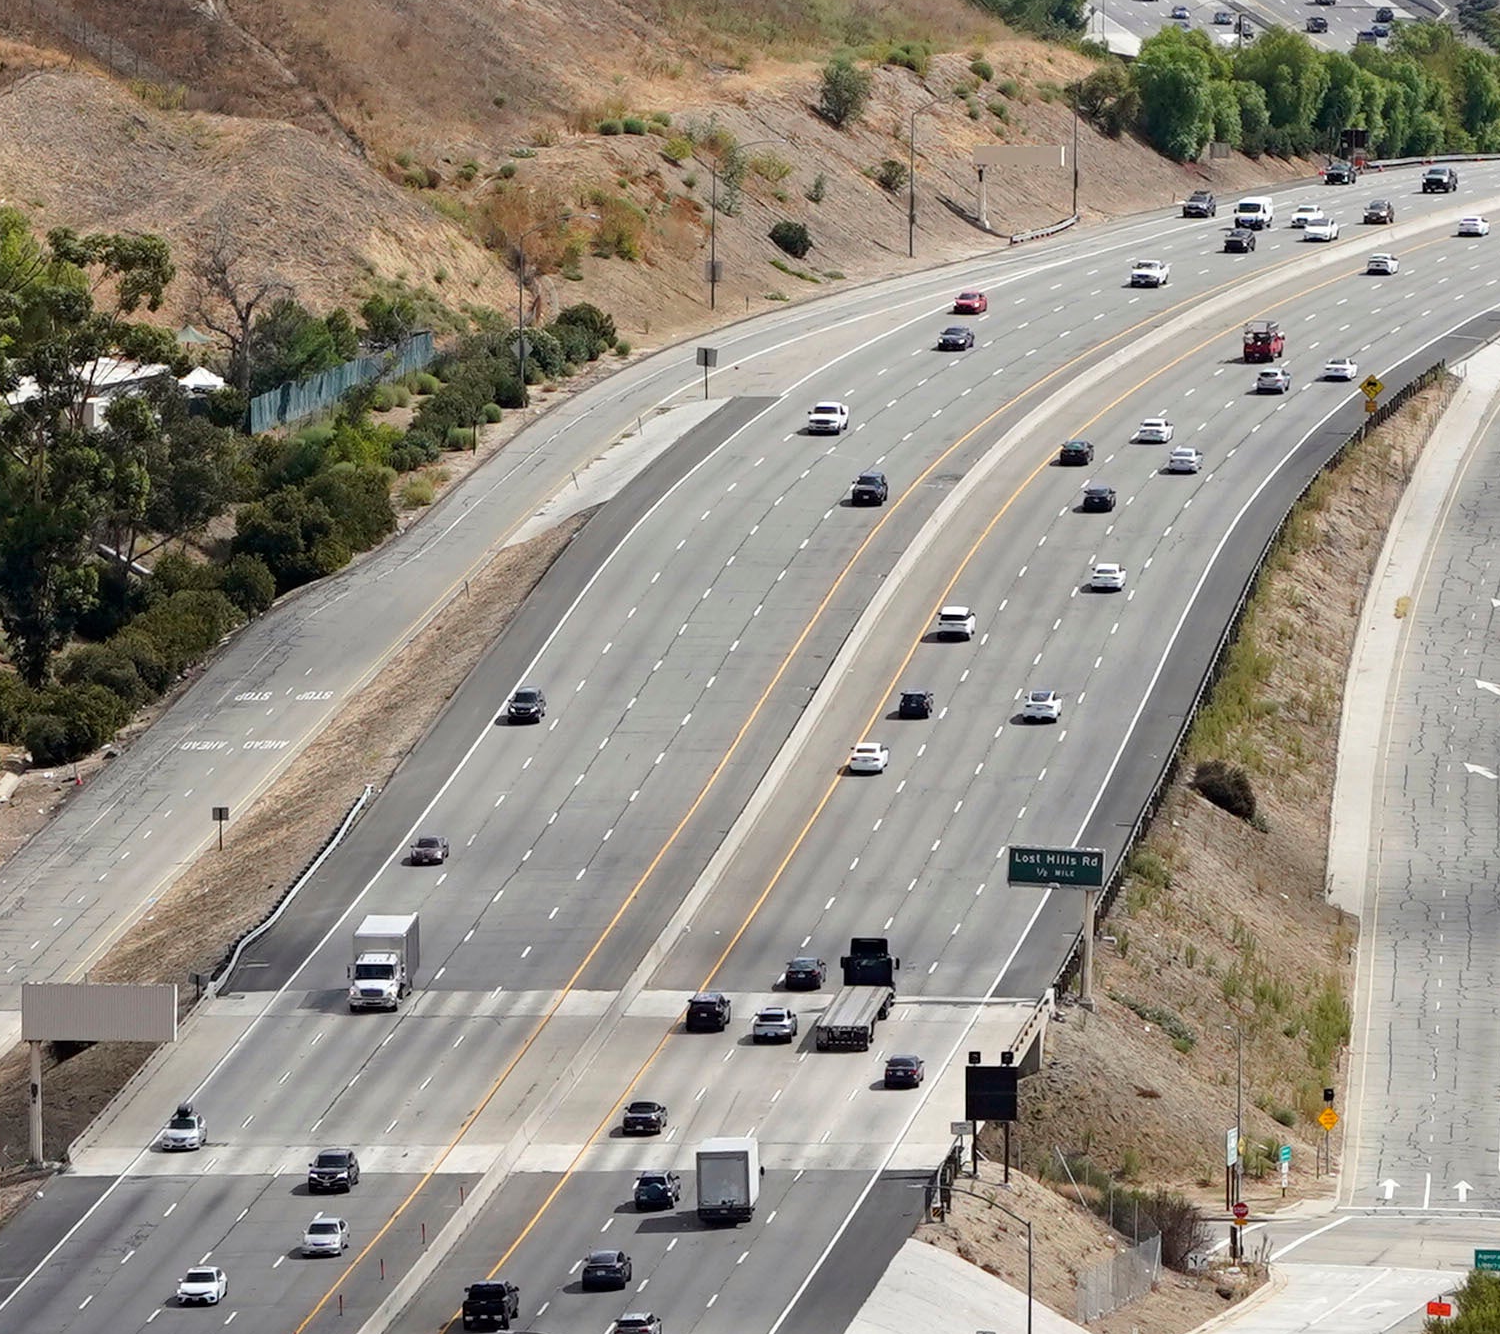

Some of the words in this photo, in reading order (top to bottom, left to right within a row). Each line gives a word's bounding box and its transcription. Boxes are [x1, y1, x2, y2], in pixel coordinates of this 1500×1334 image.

[234, 691, 273, 701] STOP
[295, 690, 335, 701] STOP
[181, 740, 228, 751] AHEAD
[243, 739, 290, 750] AHEAD
[1015, 852, 1041, 864] Lost
[1046, 854, 1077, 866] Hills
[1082, 856, 1098, 867] Rd
[1054, 868, 1075, 877] MILE
